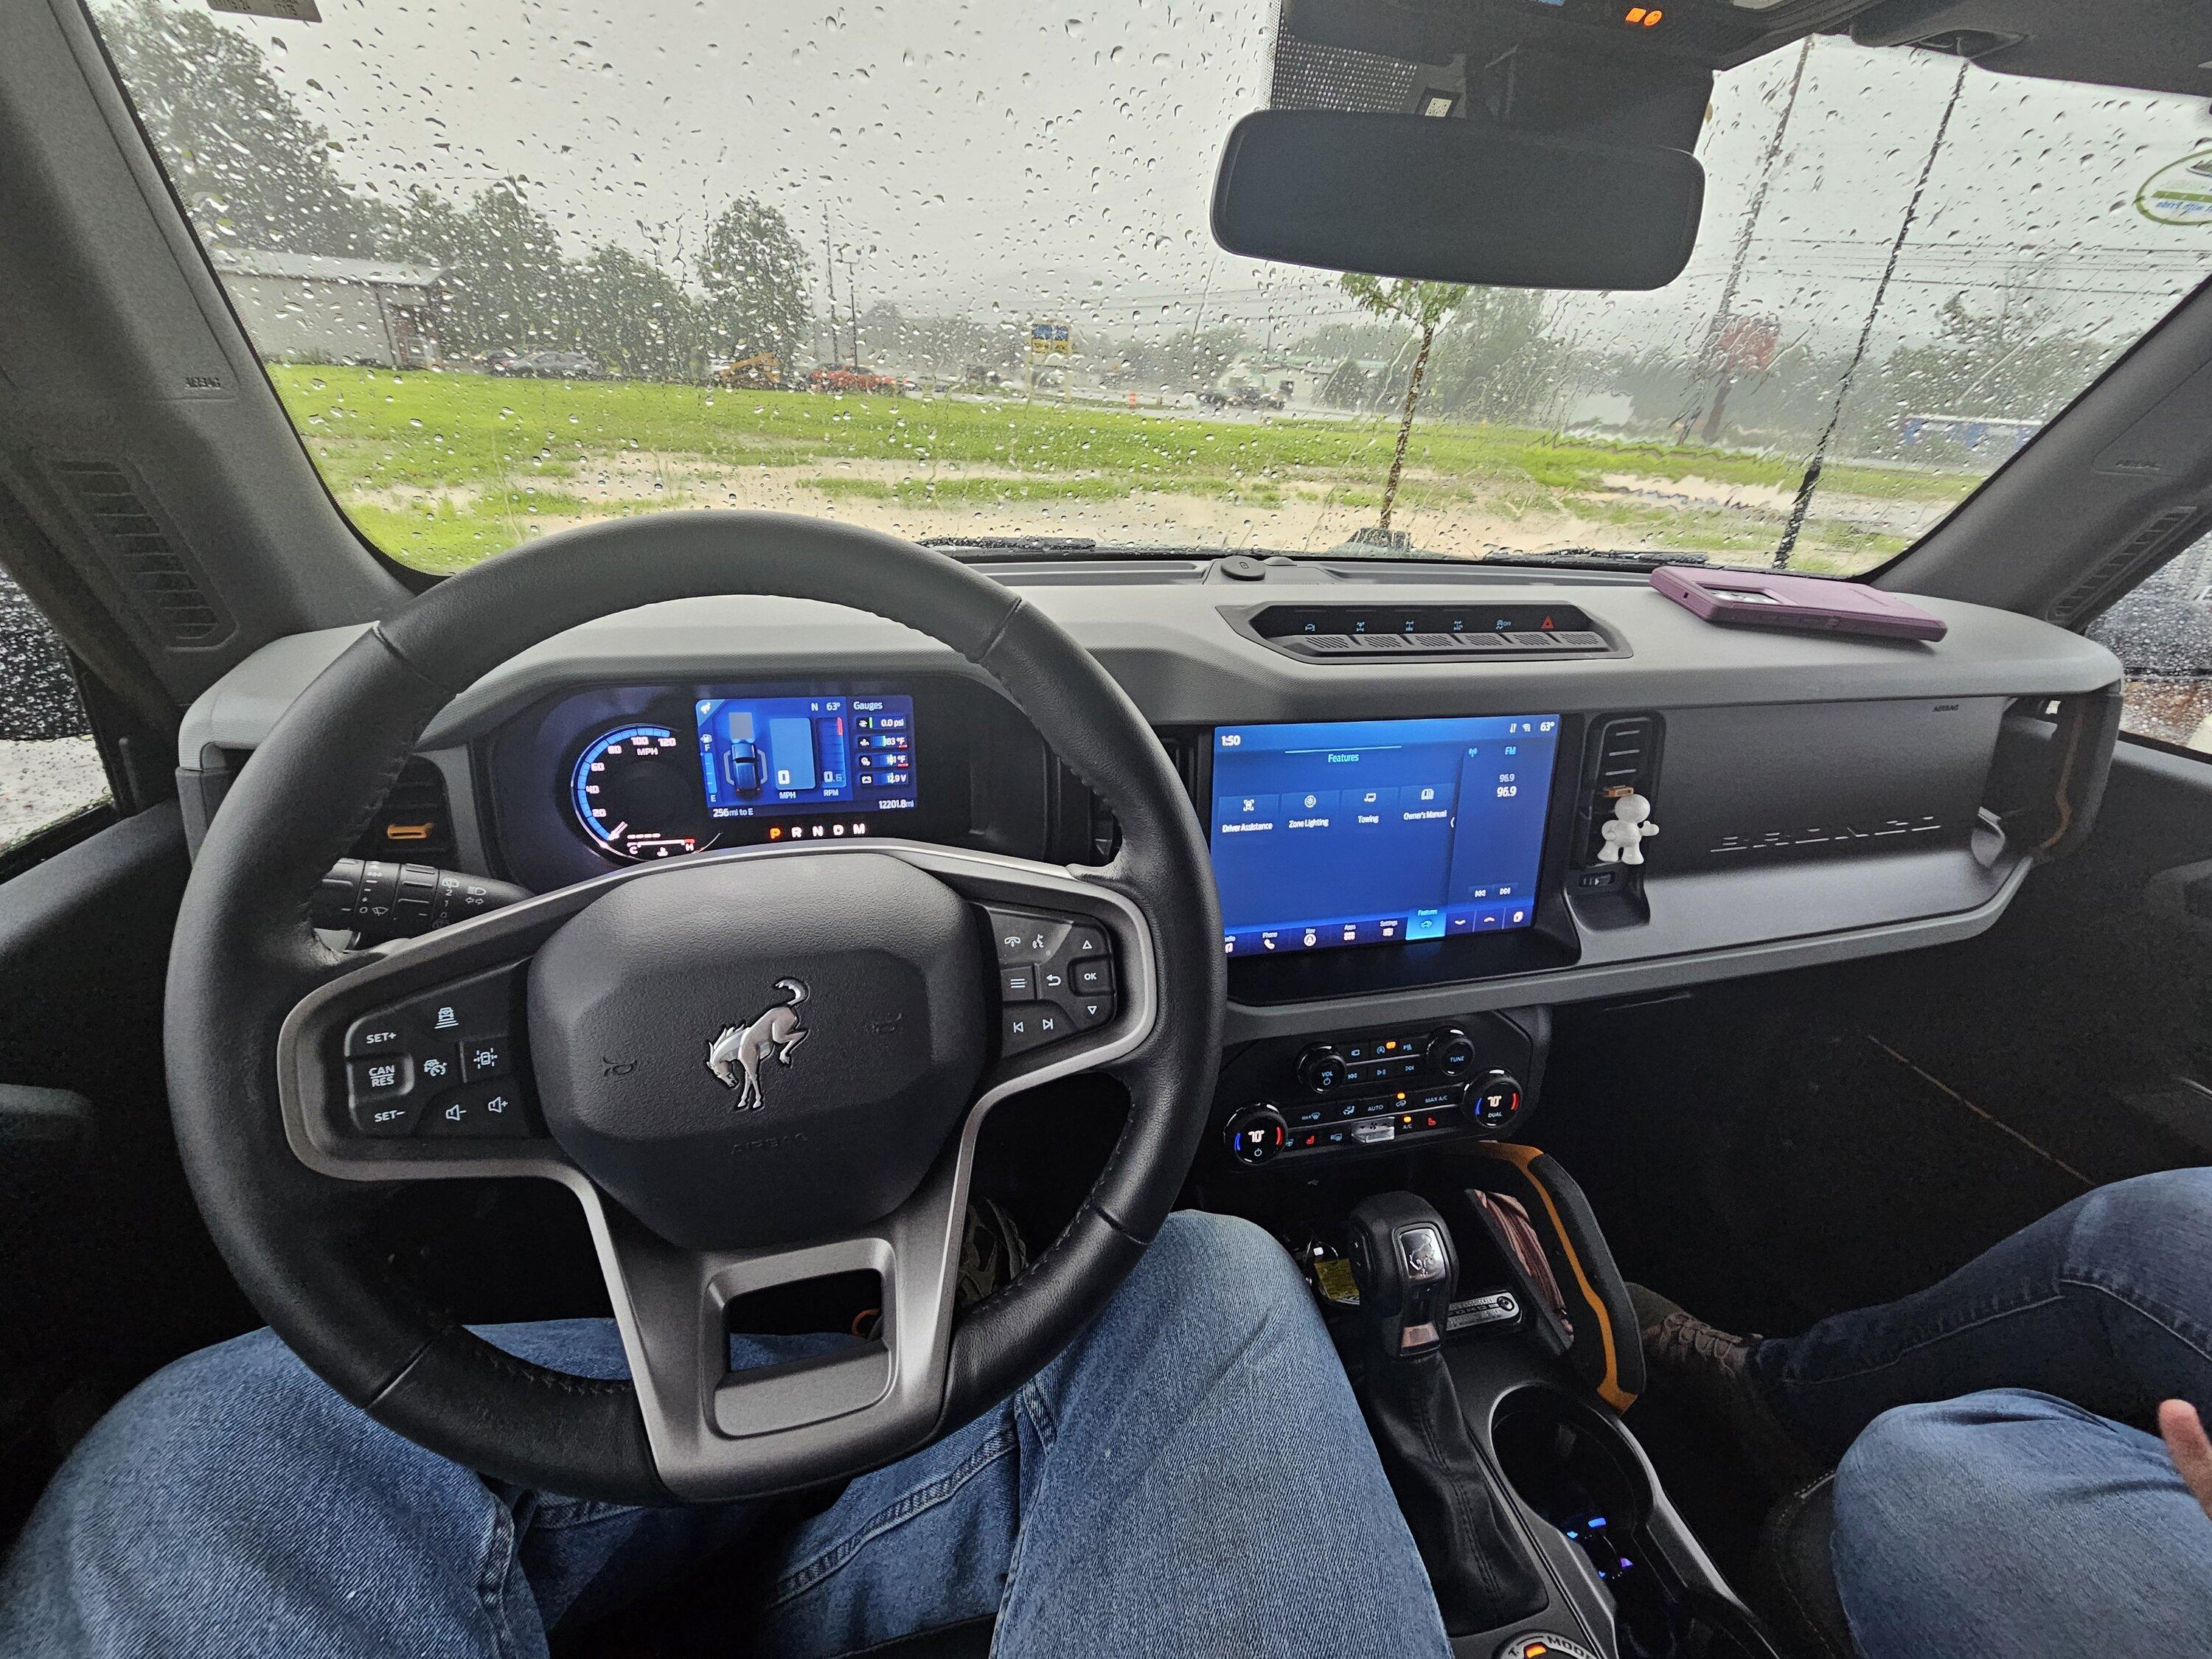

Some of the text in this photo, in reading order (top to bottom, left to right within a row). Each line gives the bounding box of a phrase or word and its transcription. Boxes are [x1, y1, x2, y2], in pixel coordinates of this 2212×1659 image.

[811, 703, 818, 711] N
[853, 701, 883, 711] Gauges
[880, 719, 894, 727] 0.0
[631, 736, 649, 745] 100
[658, 737, 676, 747] 120
[1221, 735, 1241, 746] 1:50
[608, 745, 622, 754] 80
[636, 747, 658, 756] MPH
[1505, 746, 1517, 756] FM
[1328, 754, 1360, 762] Features
[591, 762, 605, 771] 60
[777, 770, 790, 785] 0
[900, 774, 907, 783] V
[1499, 774, 1515, 783] 96.9
[585, 785, 600, 794] 40
[1496, 786, 1517, 798] 96.9
[779, 791, 796, 799] MPH
[592, 808, 607, 818] 20
[748, 807, 754, 816] E
[1403, 810, 1447, 821] Owner's Manual
[1288, 818, 1329, 829] Zone Lighting
[1357, 815, 1379, 824] Towing
[770, 823, 866, 839] P R N D M
[1222, 822, 1273, 833] Driver Assistance
[629, 846, 639, 855] C
[445, 888, 453, 897] 2
[1084, 973, 1097, 981] OK
[366, 1032, 397, 1044] SET+
[369, 1065, 395, 1077] CAN
[372, 1076, 394, 1088] RES
